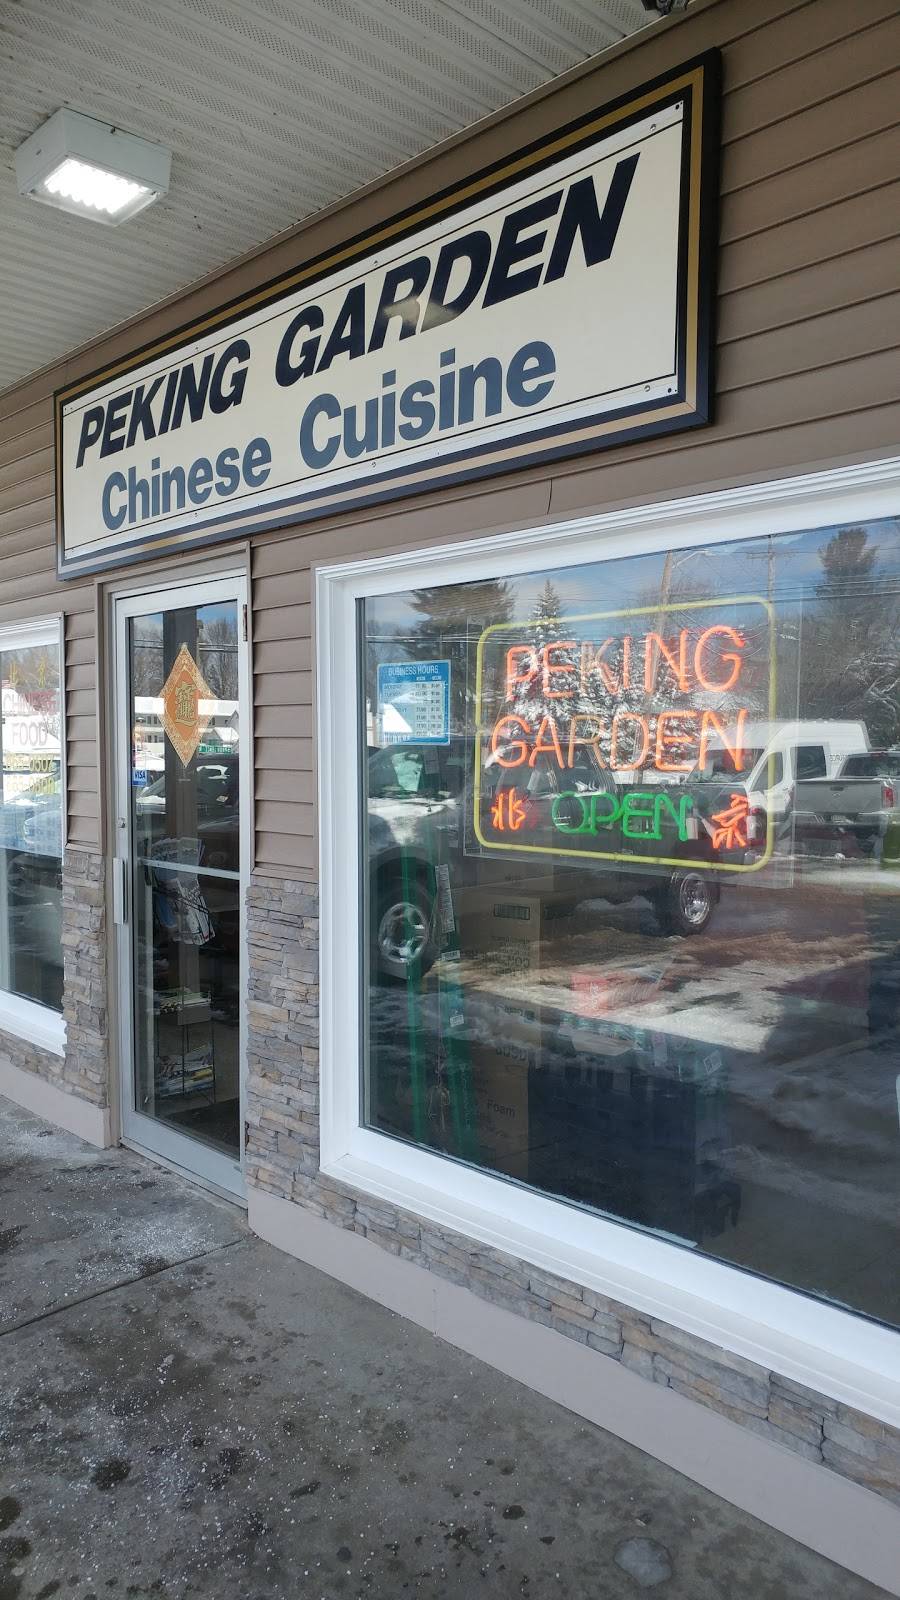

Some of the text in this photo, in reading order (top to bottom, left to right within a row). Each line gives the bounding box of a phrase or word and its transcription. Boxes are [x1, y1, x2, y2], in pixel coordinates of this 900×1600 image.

[76, 152, 641, 469] PEKING GARDEN
[102, 340, 557, 530] Chinese Cuisine
[417, 664, 439, 675] HOURS
[506, 625, 745, 702] PEKING
[12, 722, 48, 747] FOOD
[491, 708, 748, 772] GARDEN
[135, 769, 146, 779] VISA
[552, 791, 693, 842] OPEN
[487, 1099, 515, 1118] Foam
